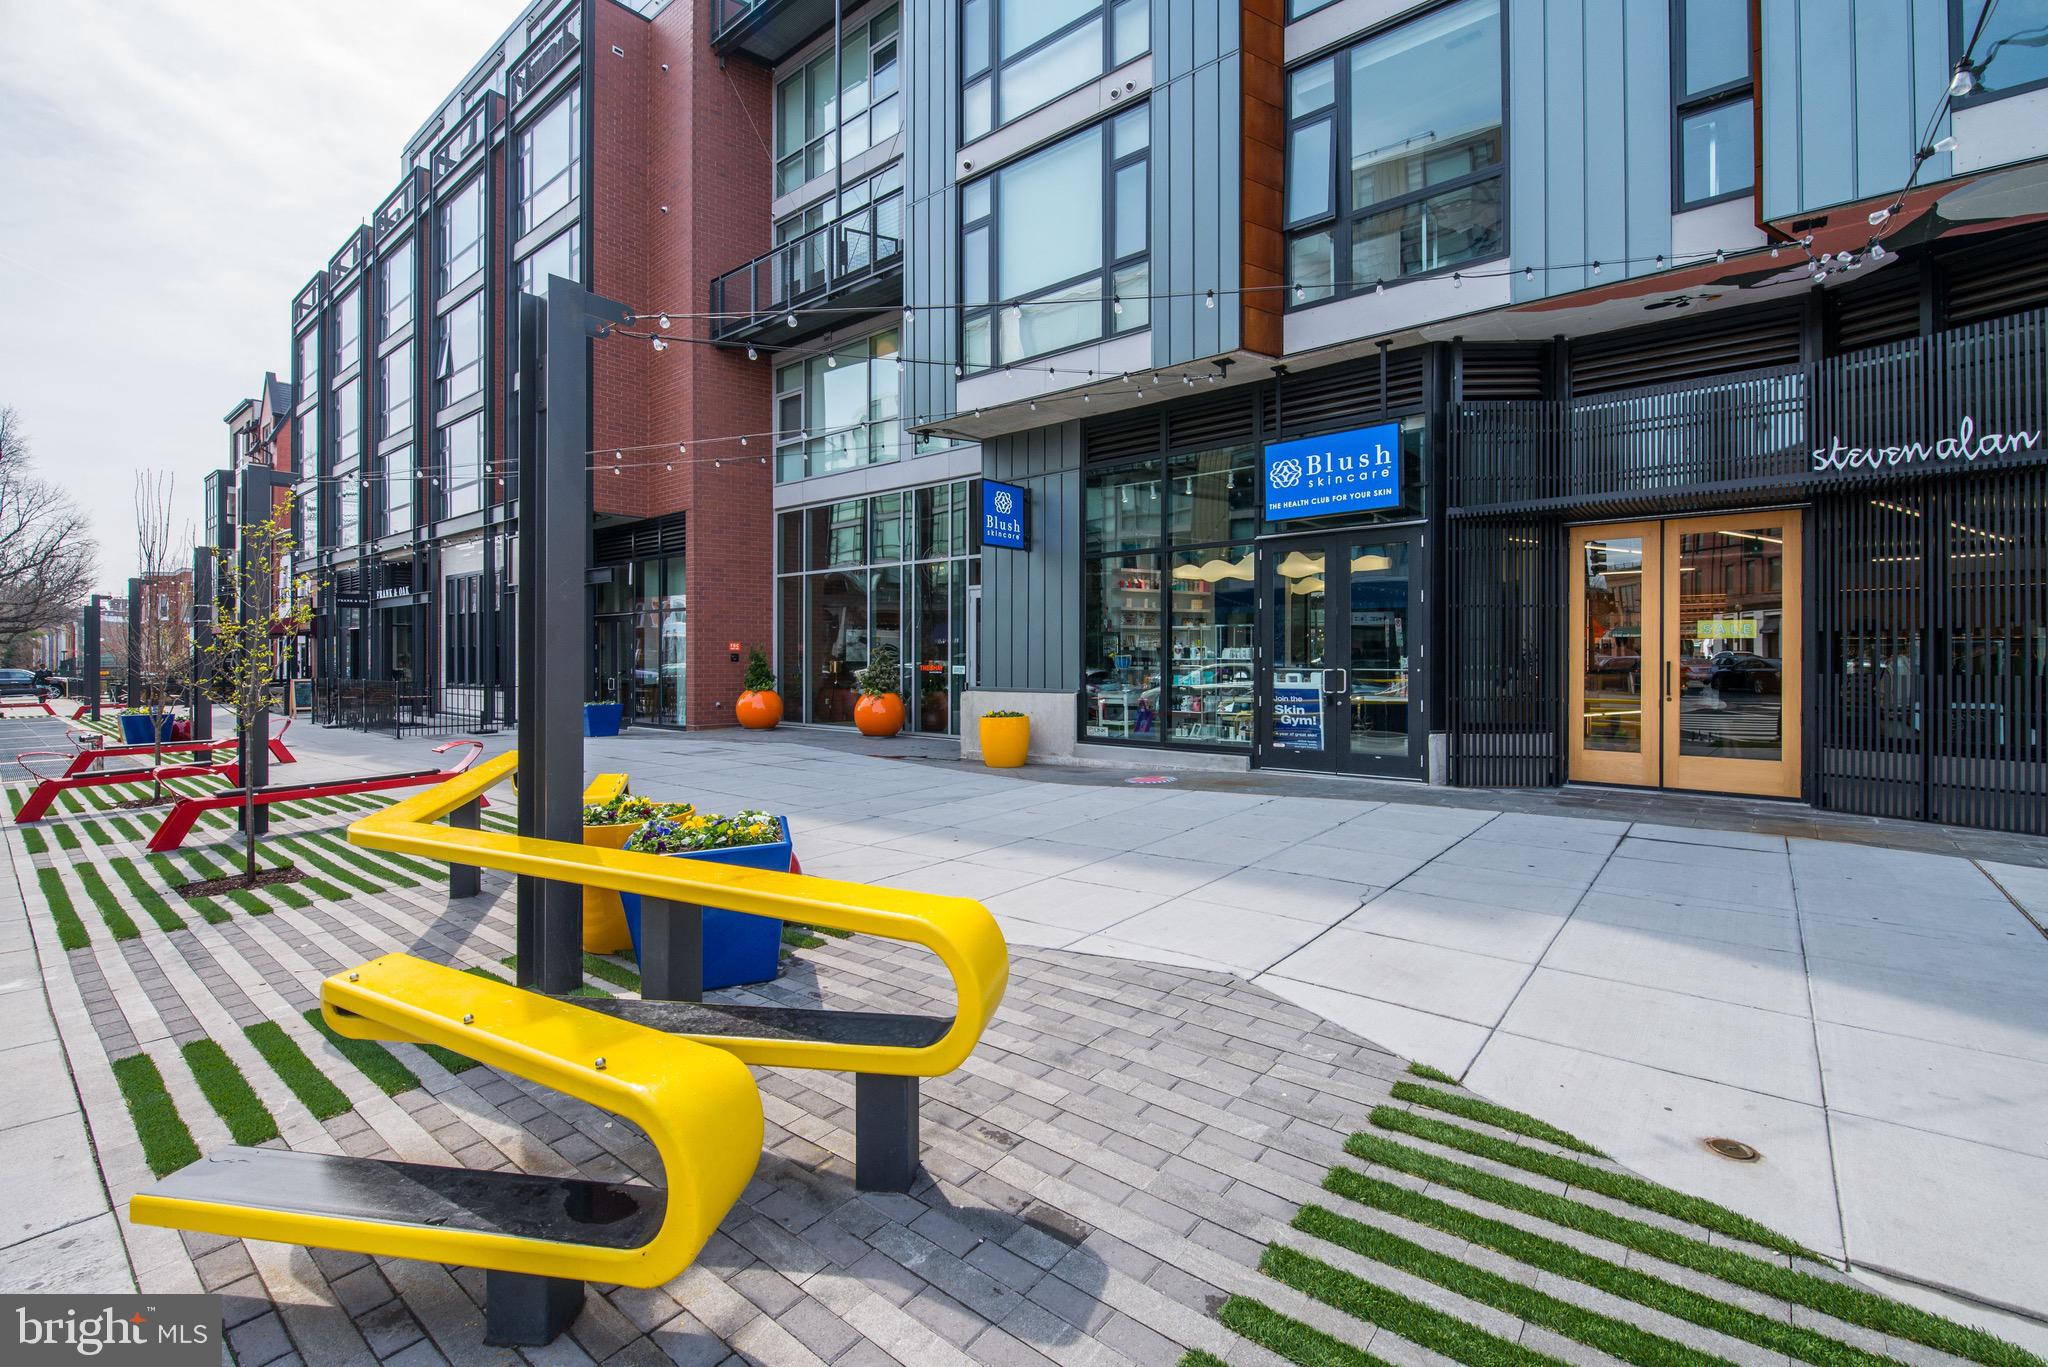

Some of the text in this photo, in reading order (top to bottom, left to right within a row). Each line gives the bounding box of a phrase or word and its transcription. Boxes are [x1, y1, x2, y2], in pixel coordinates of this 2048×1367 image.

[1812, 415, 2041, 471] steven alan
[1305, 444, 1392, 476] Blush
[1308, 468, 1390, 488] skincare
[1269, 487, 1392, 511] THE HEALTH CLUB FOR YOUR SKIN
[986, 514, 1020, 533] Blush
[987, 530, 1020, 541] skincare
[377, 589, 393, 599] FRANK
[399, 586, 409, 597] OAK
[1703, 623, 1752, 635] SALE
[1274, 704, 1305, 714] Skin
[1280, 715, 1317, 727] Gym!
